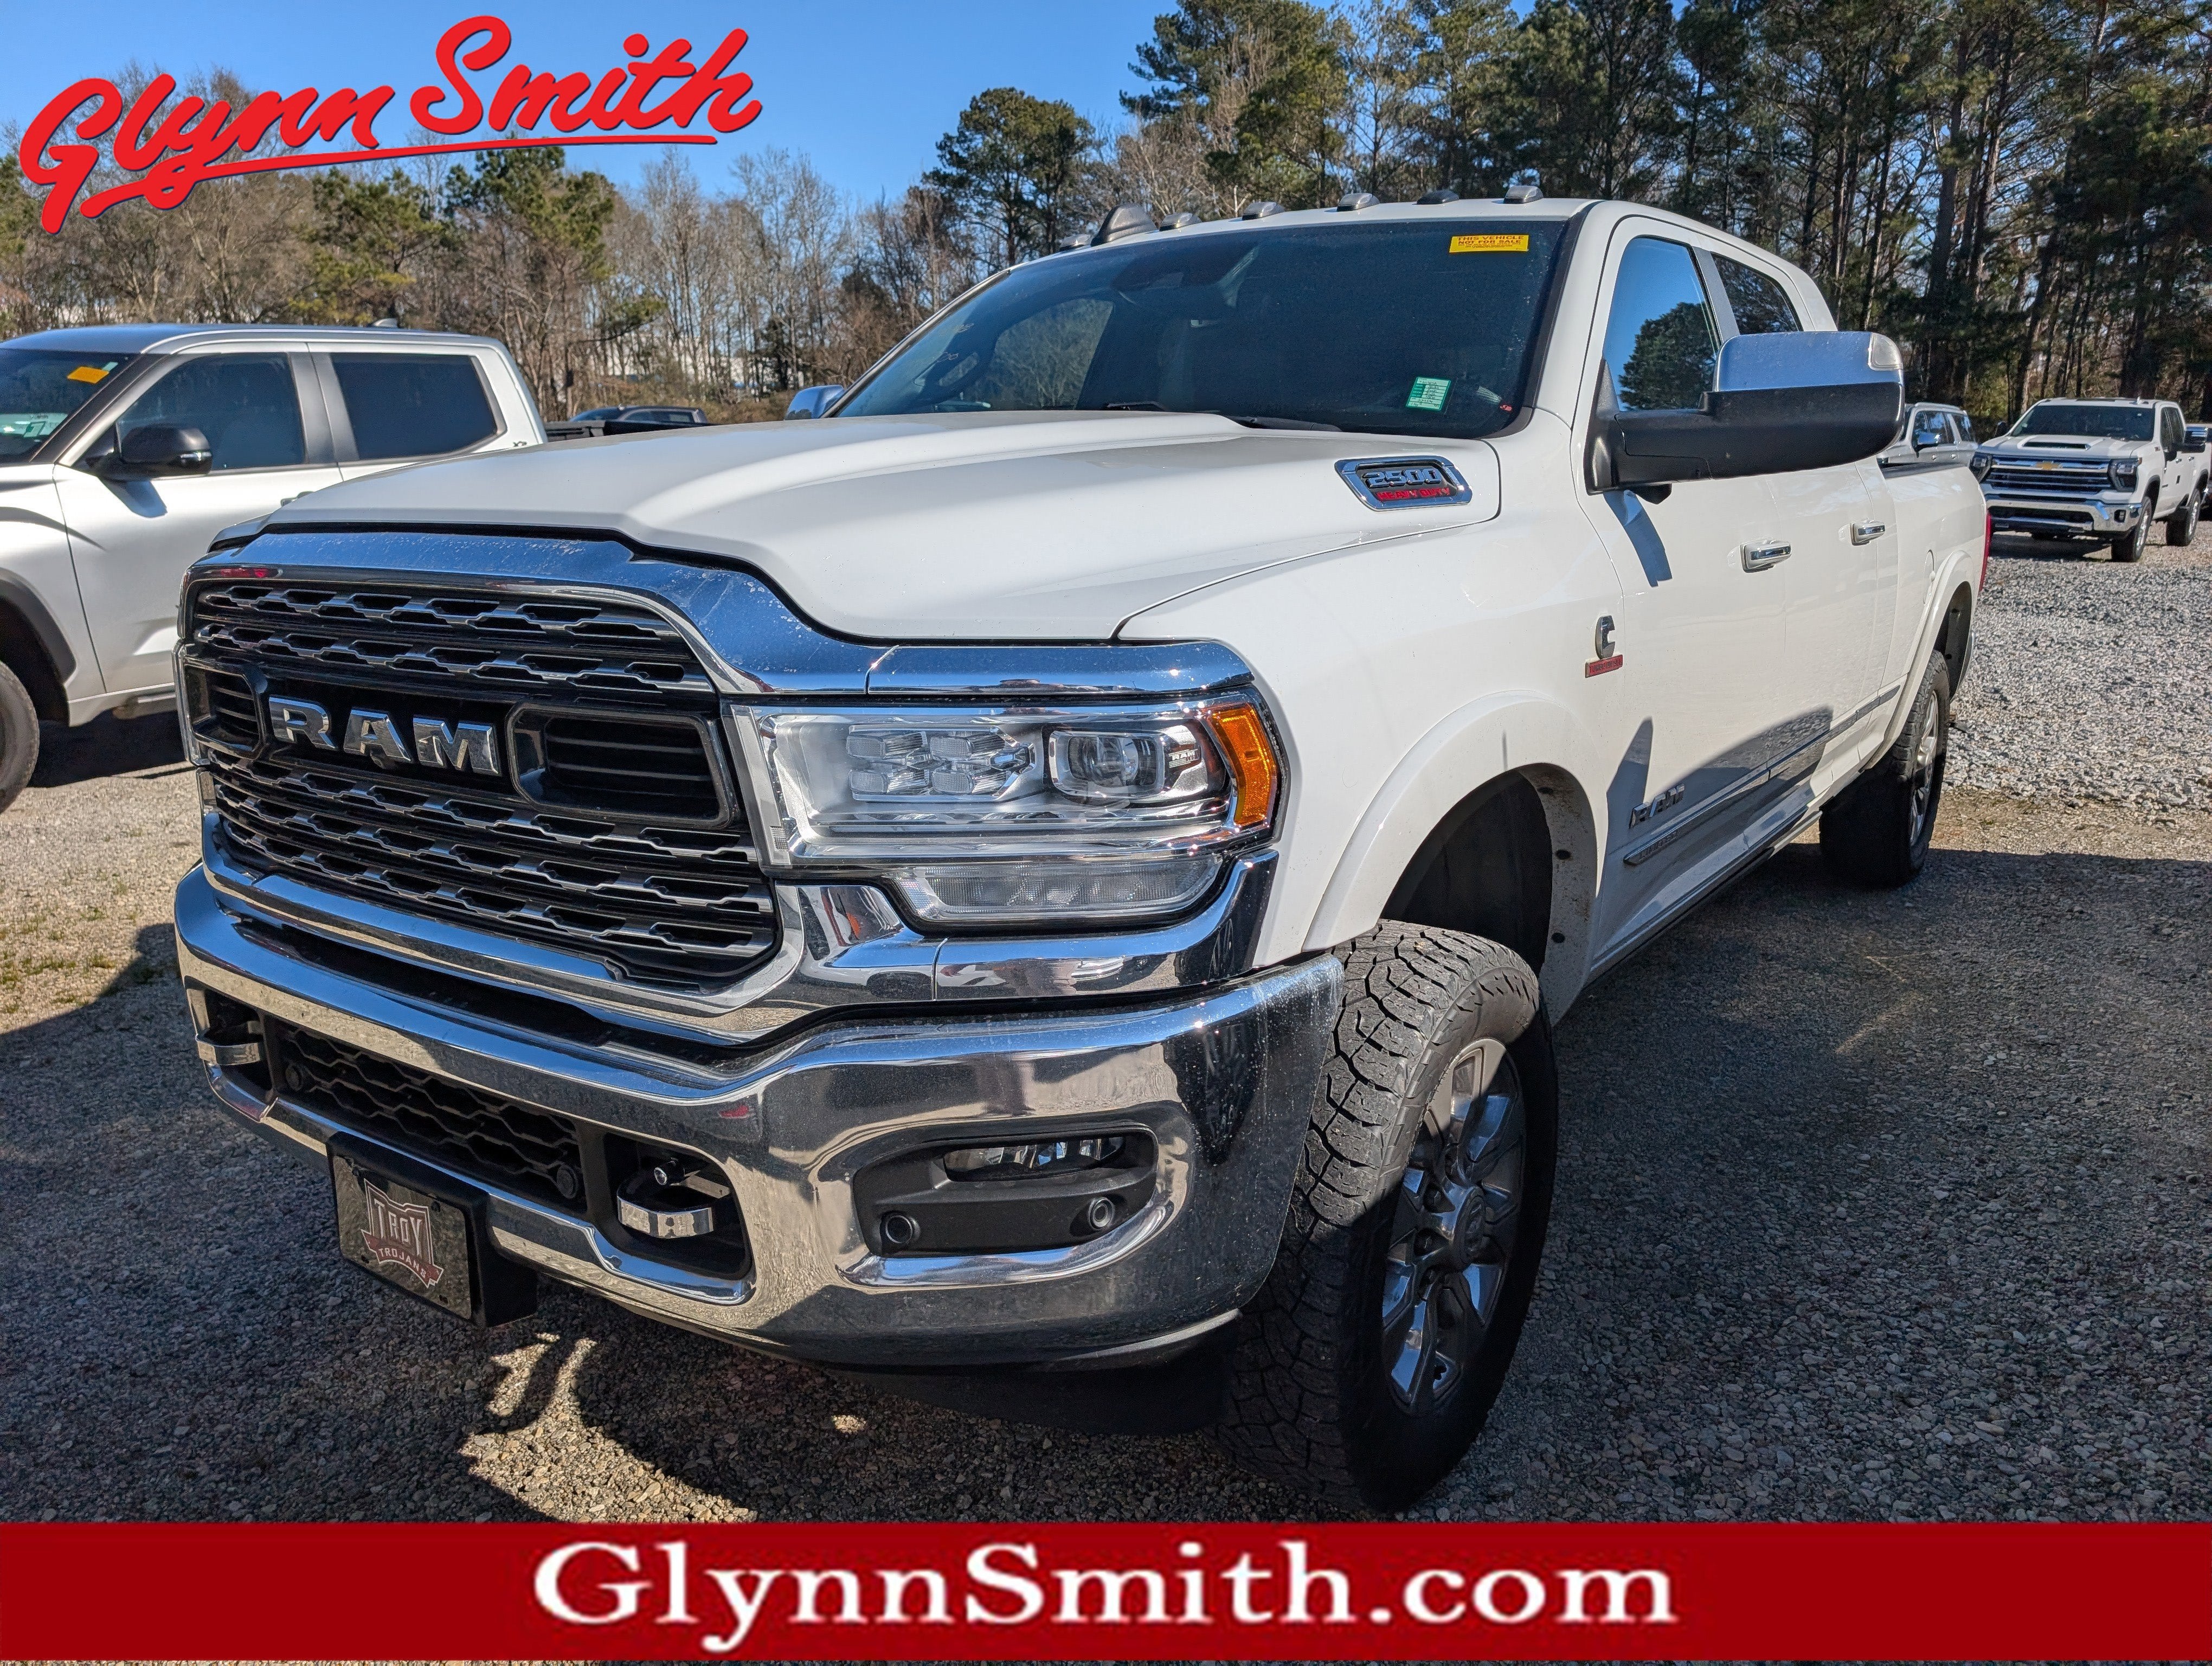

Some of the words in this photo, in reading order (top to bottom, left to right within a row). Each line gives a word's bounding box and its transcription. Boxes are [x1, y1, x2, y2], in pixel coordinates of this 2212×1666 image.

[1362, 468, 1443, 489] 2500
[268, 696, 502, 777] RAM
[1172, 750, 1195, 761] RAM
[374, 1197, 423, 1257] TROY
[378, 1247, 426, 1278] TROJANS
